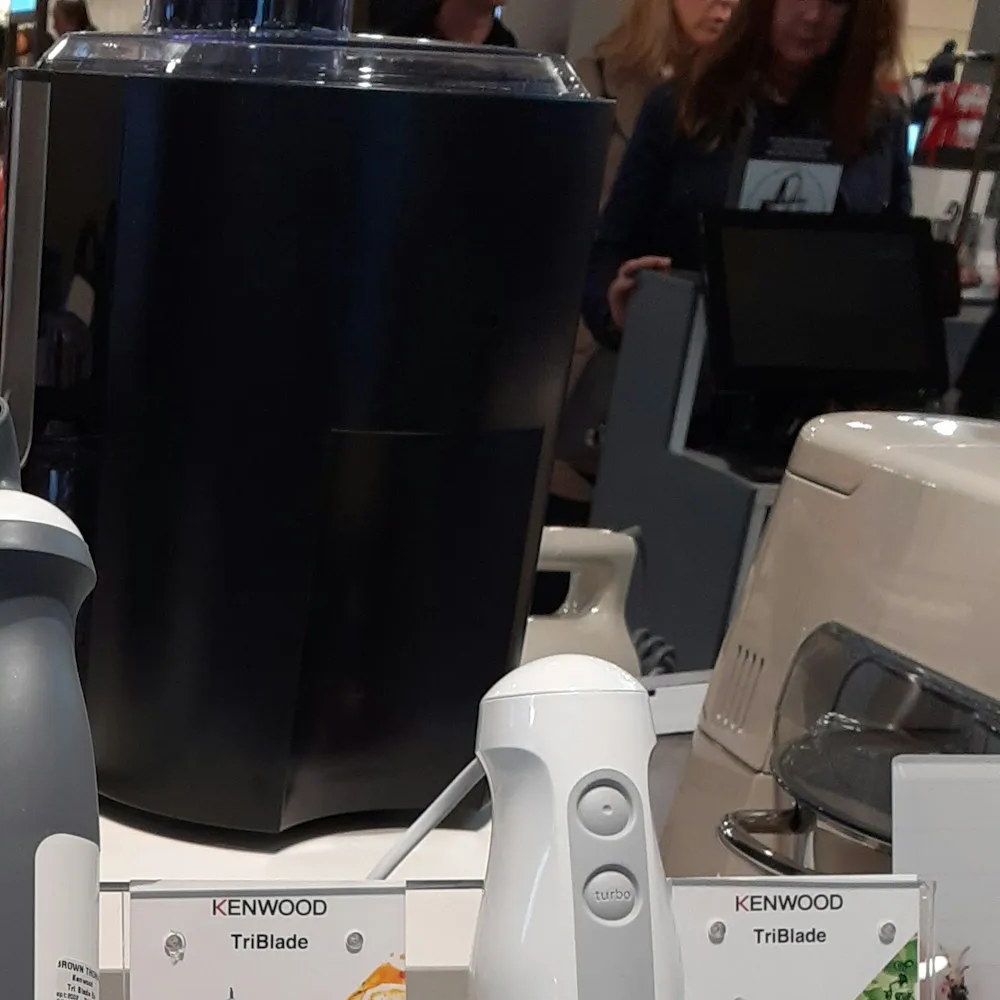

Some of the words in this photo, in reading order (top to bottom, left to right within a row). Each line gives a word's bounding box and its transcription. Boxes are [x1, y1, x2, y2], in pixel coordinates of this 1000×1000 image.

[596, 889, 630, 900] turbo
[213, 900, 328, 916] KENWOOD
[736, 894, 843, 911] KENWOOD
[231, 934, 308, 949] TriBlade
[754, 928, 826, 943] TriBlade
